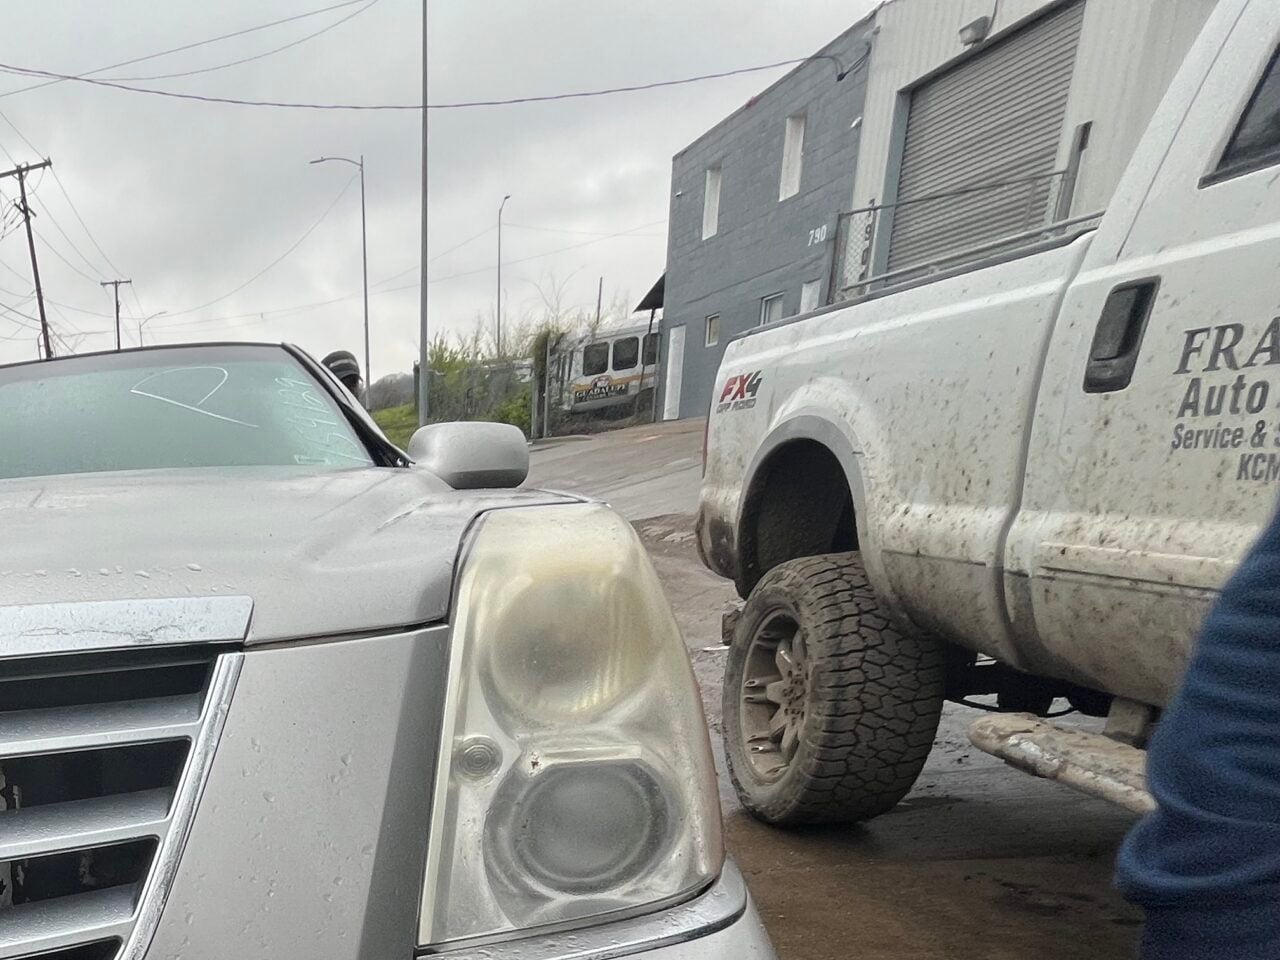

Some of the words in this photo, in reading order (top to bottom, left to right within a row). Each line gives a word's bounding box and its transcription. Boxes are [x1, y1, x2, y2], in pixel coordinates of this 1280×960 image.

[808, 224, 827, 247] 790
[1173, 316, 1280, 375] FRA
[719, 370, 762, 403] FX4
[1176, 375, 1270, 419] Auto
[1172, 422, 1244, 449] Service
[1250, 420, 1267, 448] &
